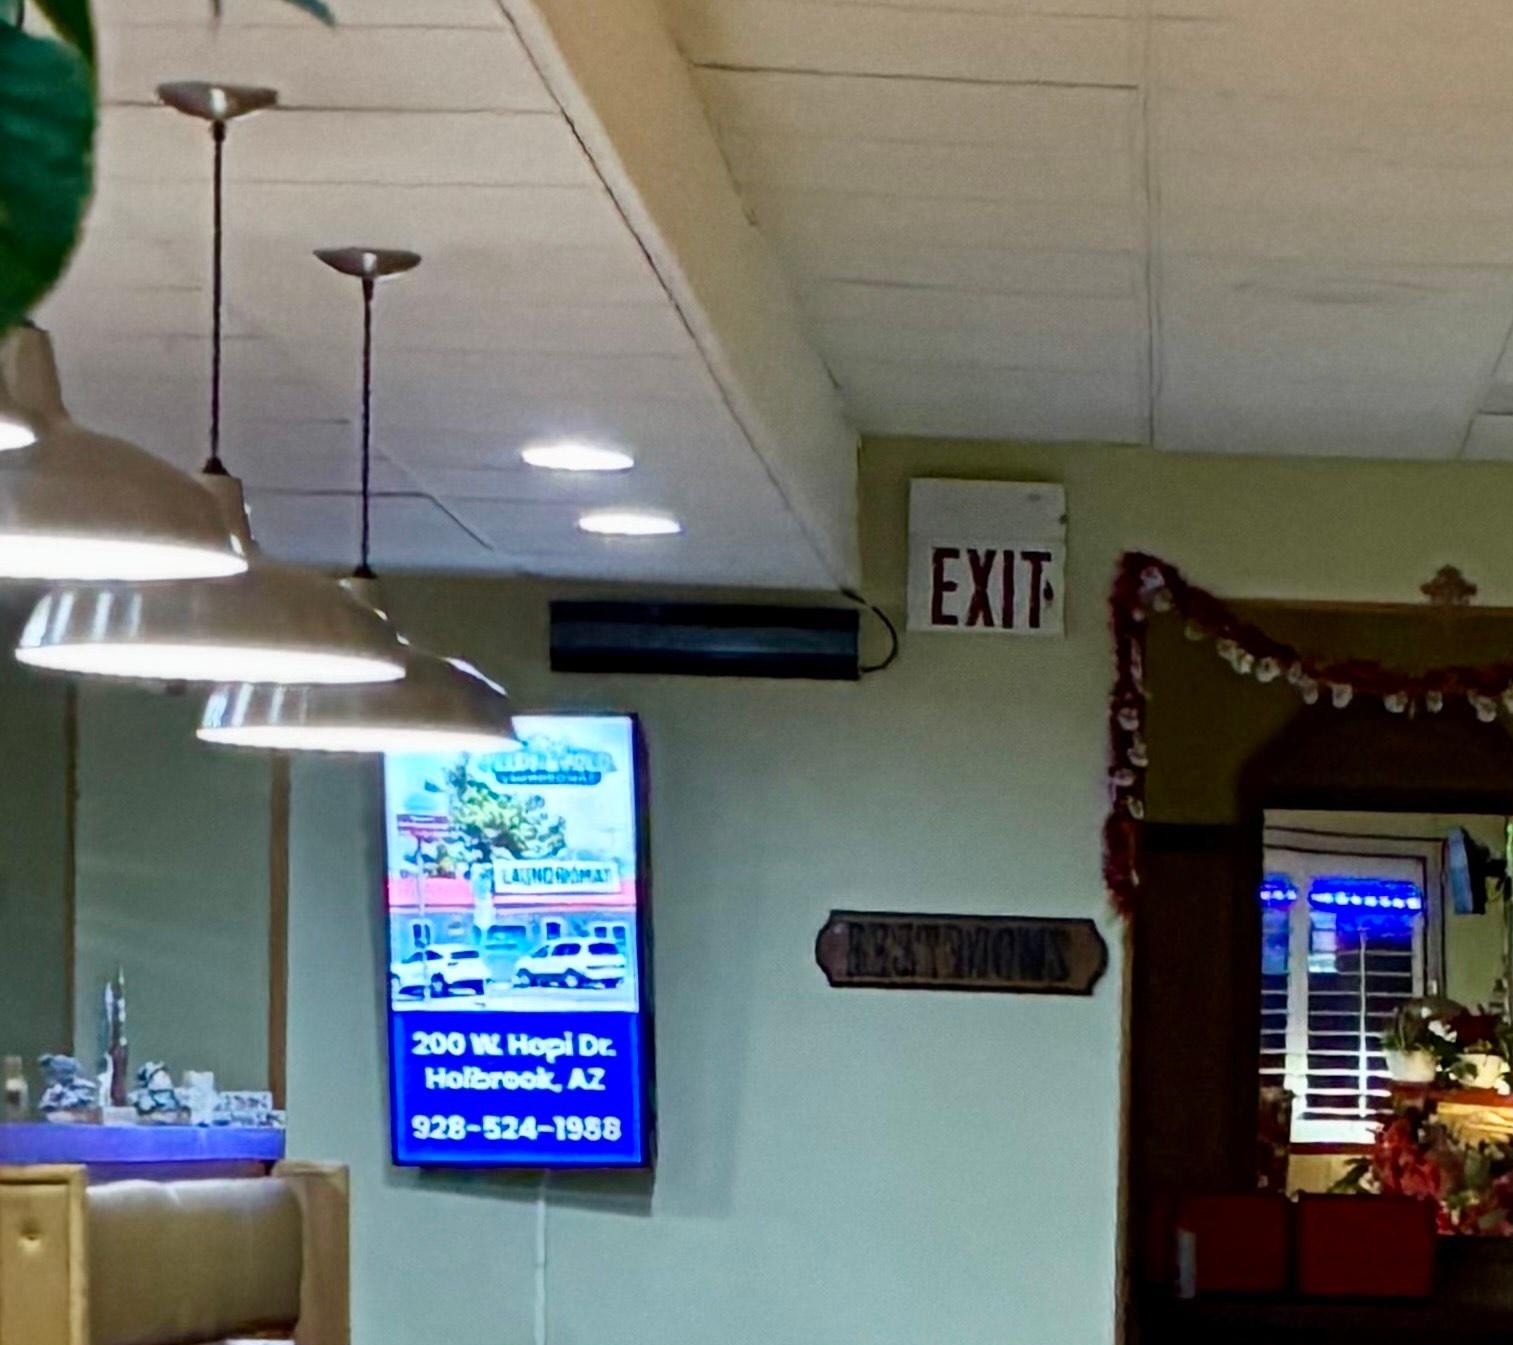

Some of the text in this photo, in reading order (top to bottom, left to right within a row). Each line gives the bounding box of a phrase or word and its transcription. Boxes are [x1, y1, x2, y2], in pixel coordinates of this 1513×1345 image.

[930, 546, 1052, 629] EXIT
[411, 1030, 617, 1064] 200 W. Hopi Dr.
[424, 1065, 606, 1093] Holbrook, AZ
